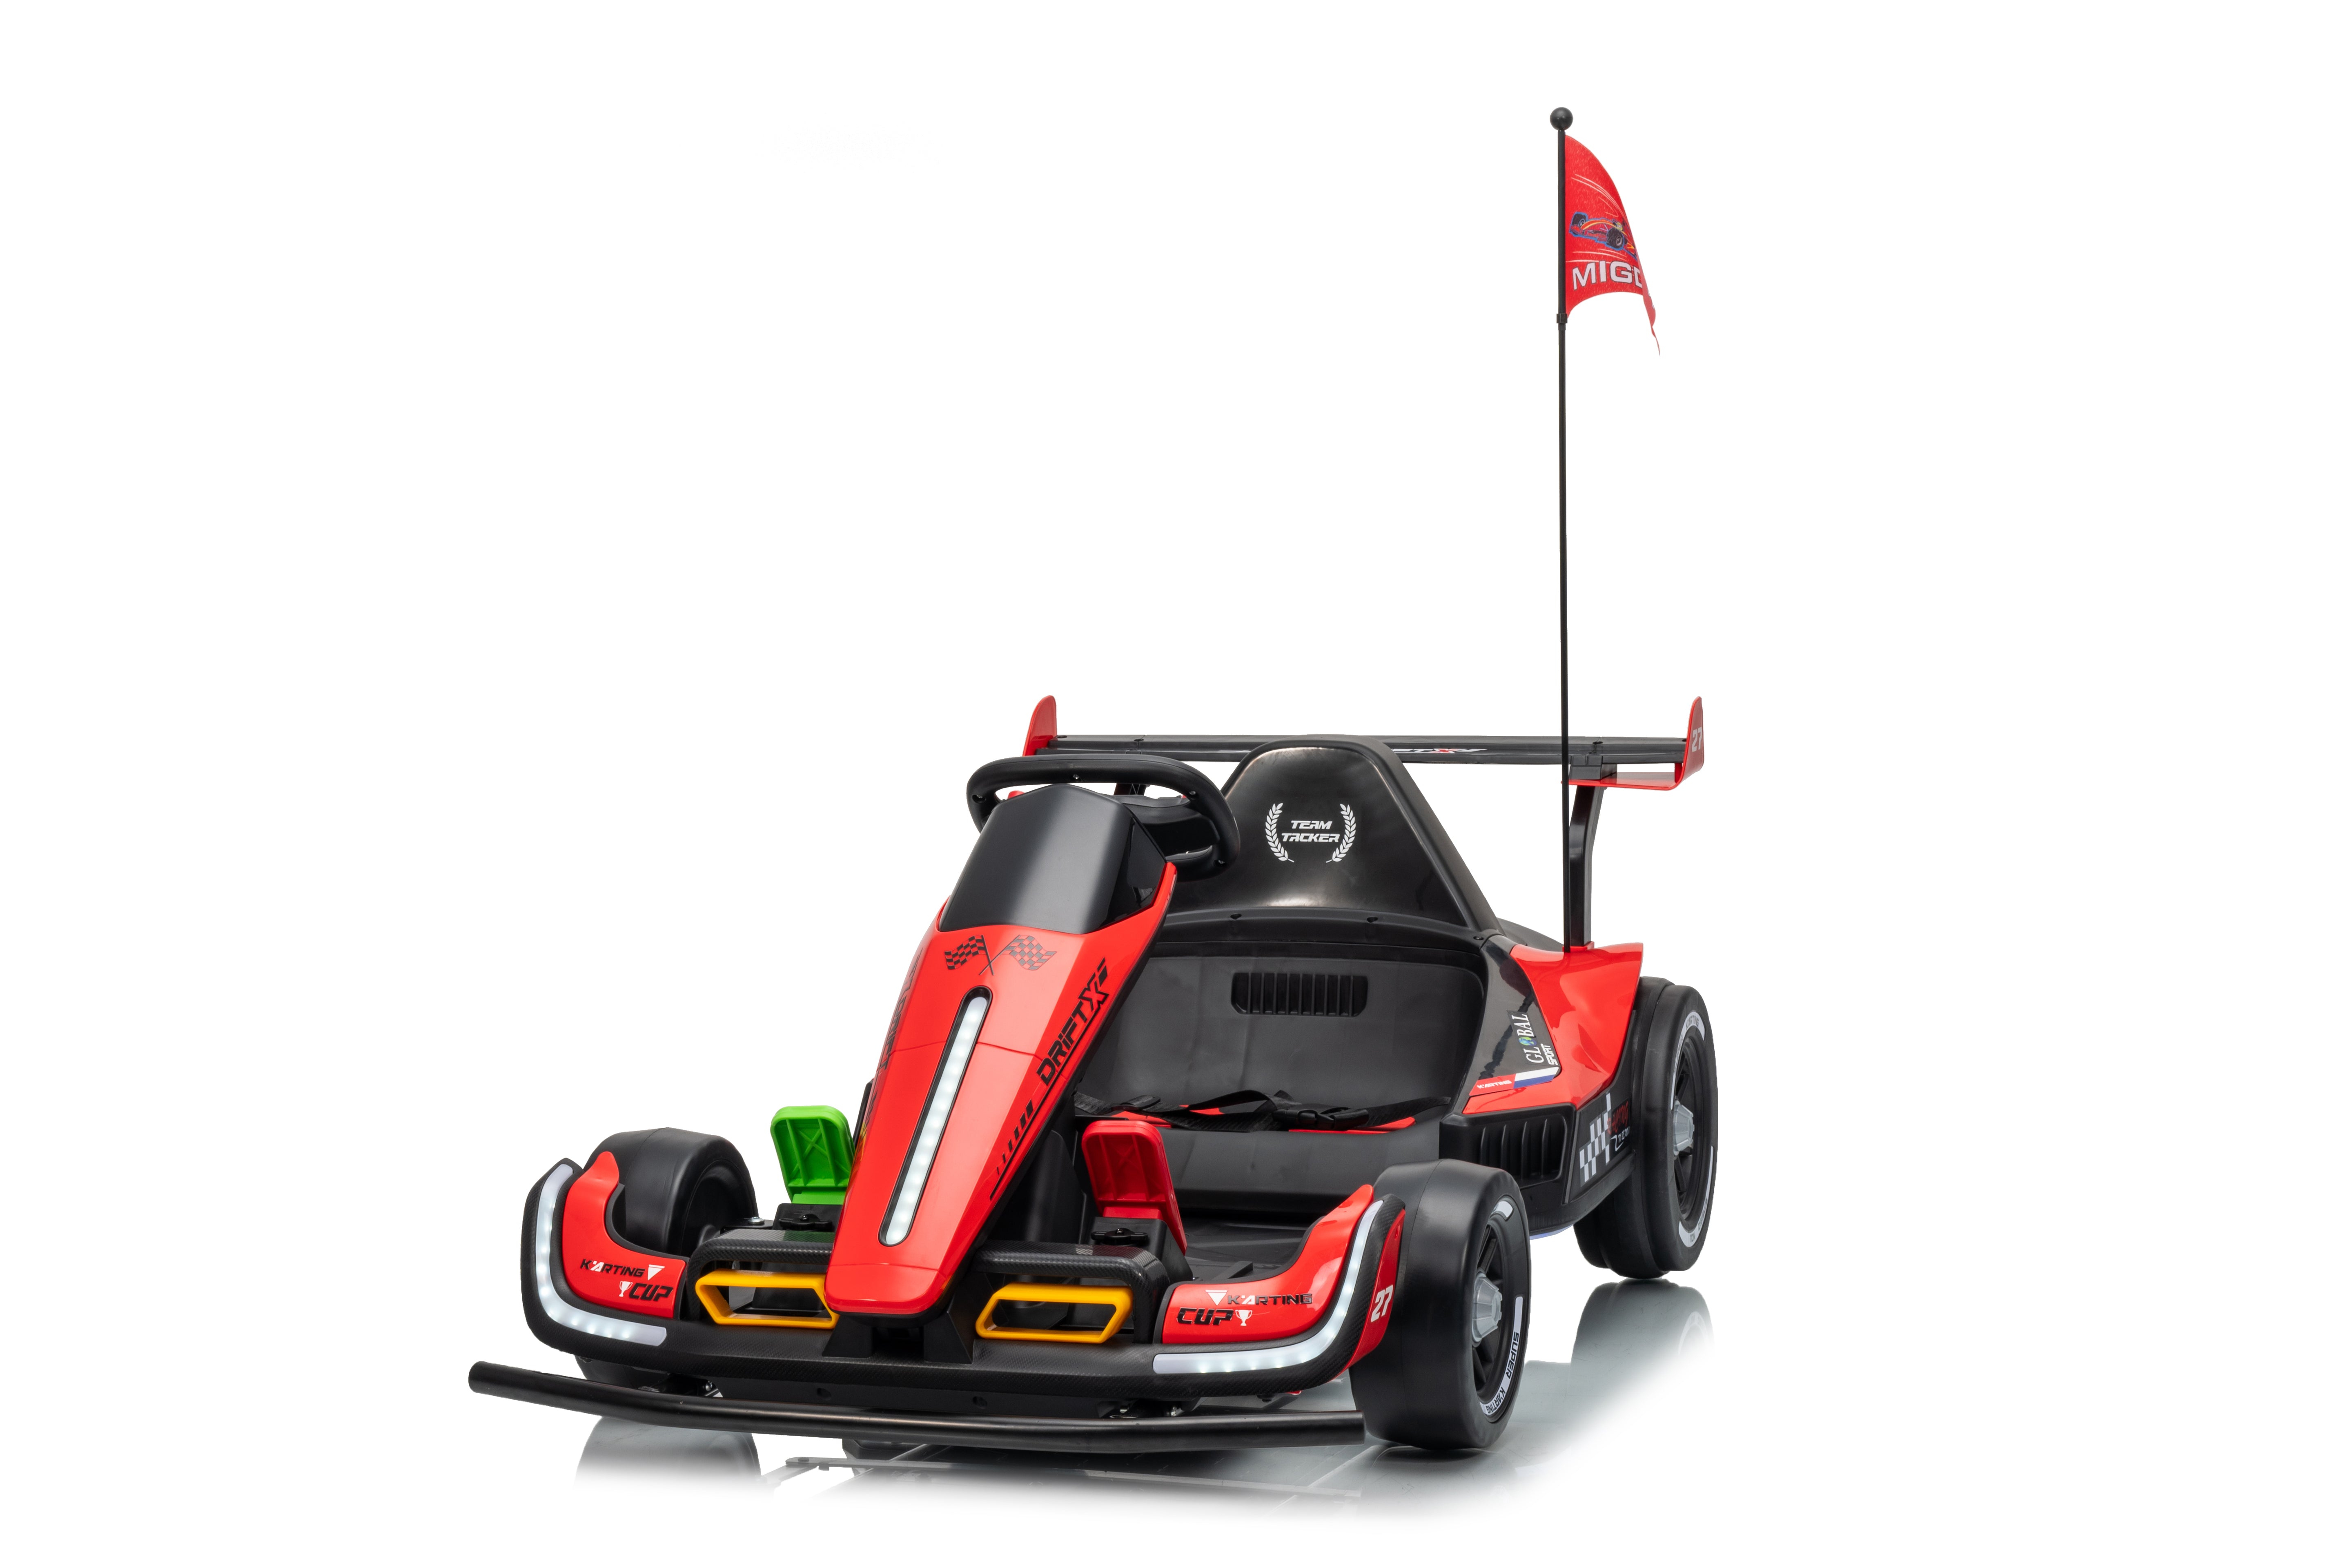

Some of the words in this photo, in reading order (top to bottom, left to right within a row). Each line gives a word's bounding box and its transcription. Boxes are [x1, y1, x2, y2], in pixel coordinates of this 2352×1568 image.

[1692, 727, 1702, 752] 27
[1291, 820, 1332, 829] TEAM
[1281, 833, 1340, 842] TACKER
[1541, 1043, 1558, 1065] SPORT
[629, 1283, 674, 1302] CUP
[1371, 1284, 1393, 1322] 27
[1177, 1307, 1234, 1325] CUP
[1506, 1331, 1519, 1379] SUPER
